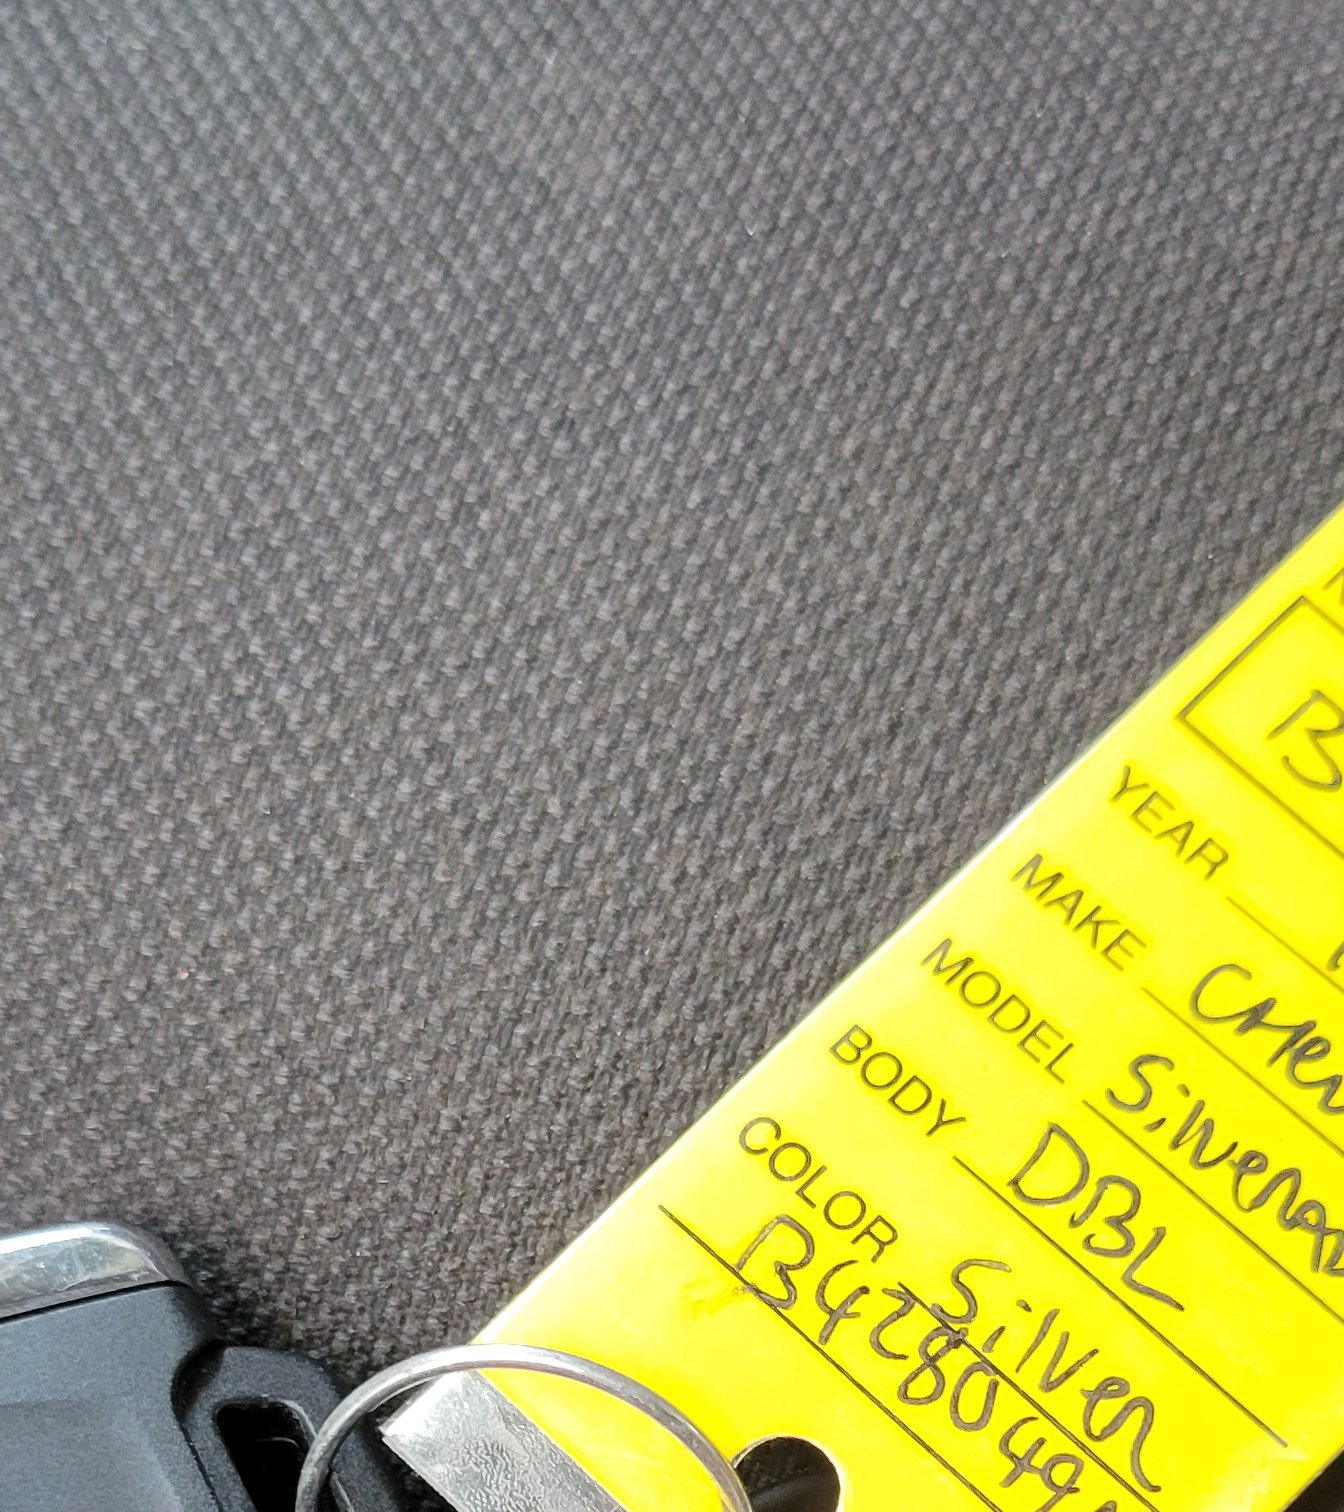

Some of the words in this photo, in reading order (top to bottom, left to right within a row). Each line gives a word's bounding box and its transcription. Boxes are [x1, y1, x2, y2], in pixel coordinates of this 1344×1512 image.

[1110, 766, 1230, 882] YEAR
[1011, 854, 1147, 971] MAKE
[921, 938, 1075, 1084] MODEL
[829, 1024, 967, 1139] BODY
[739, 1117, 899, 1262] COLOR
[1009, 1122, 1184, 1311] DBL
